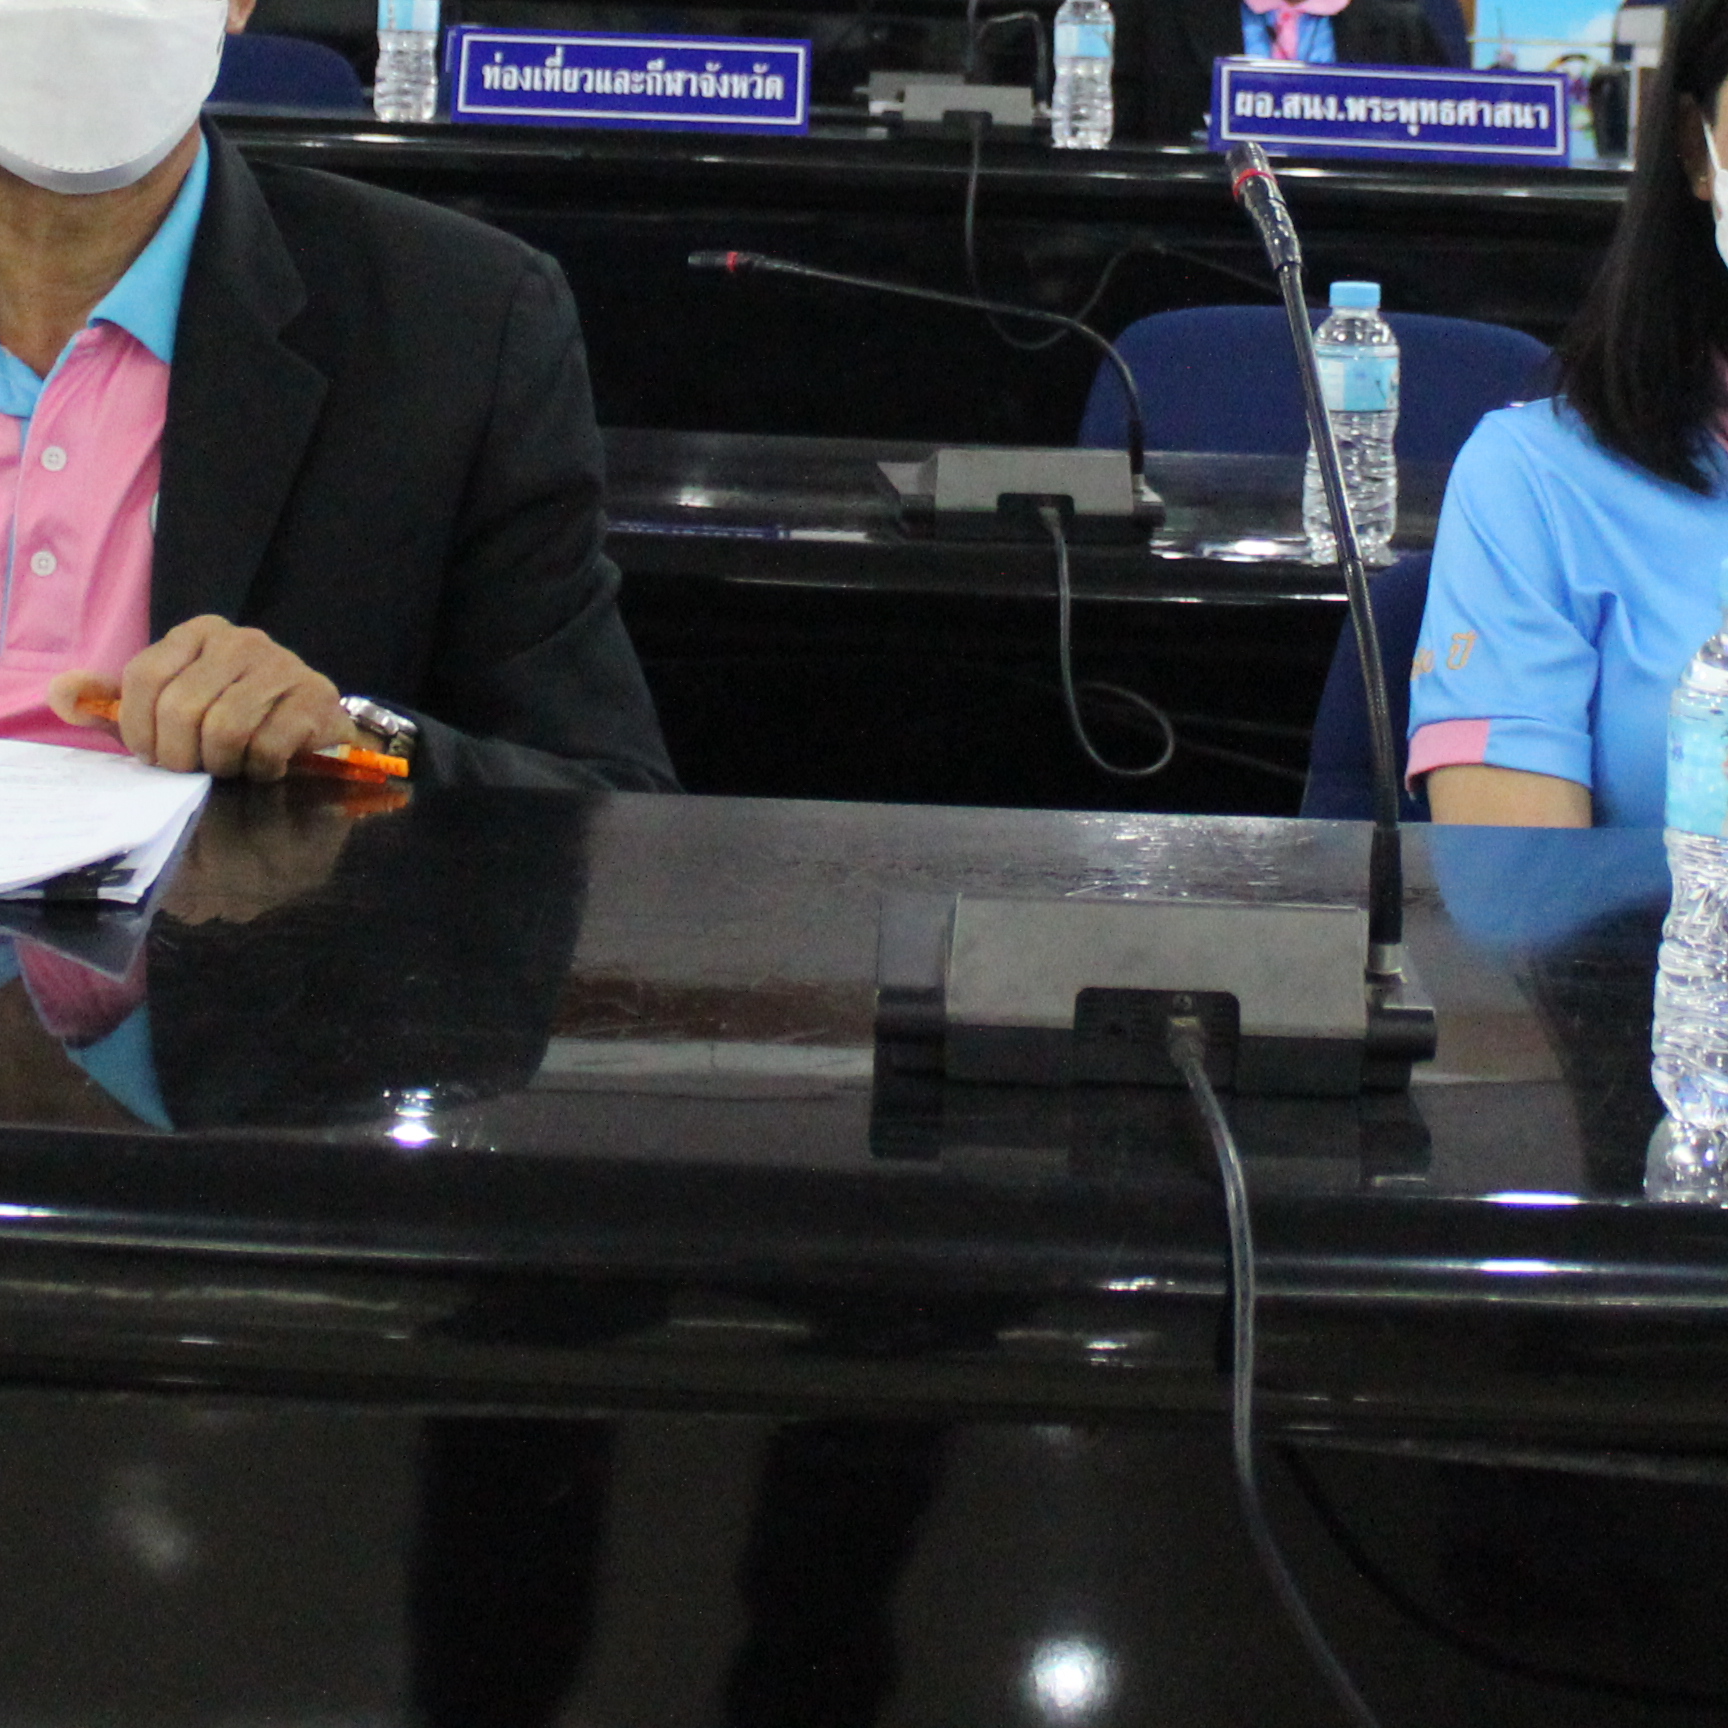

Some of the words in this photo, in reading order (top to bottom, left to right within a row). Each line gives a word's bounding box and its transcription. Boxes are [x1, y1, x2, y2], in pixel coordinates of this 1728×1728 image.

[482, 46, 785, 101] ท่องเที่ยวและกีฬาจังหวัด
[1234, 90, 1550, 137] ผอ.สนง.พระพุทธศาสนา
